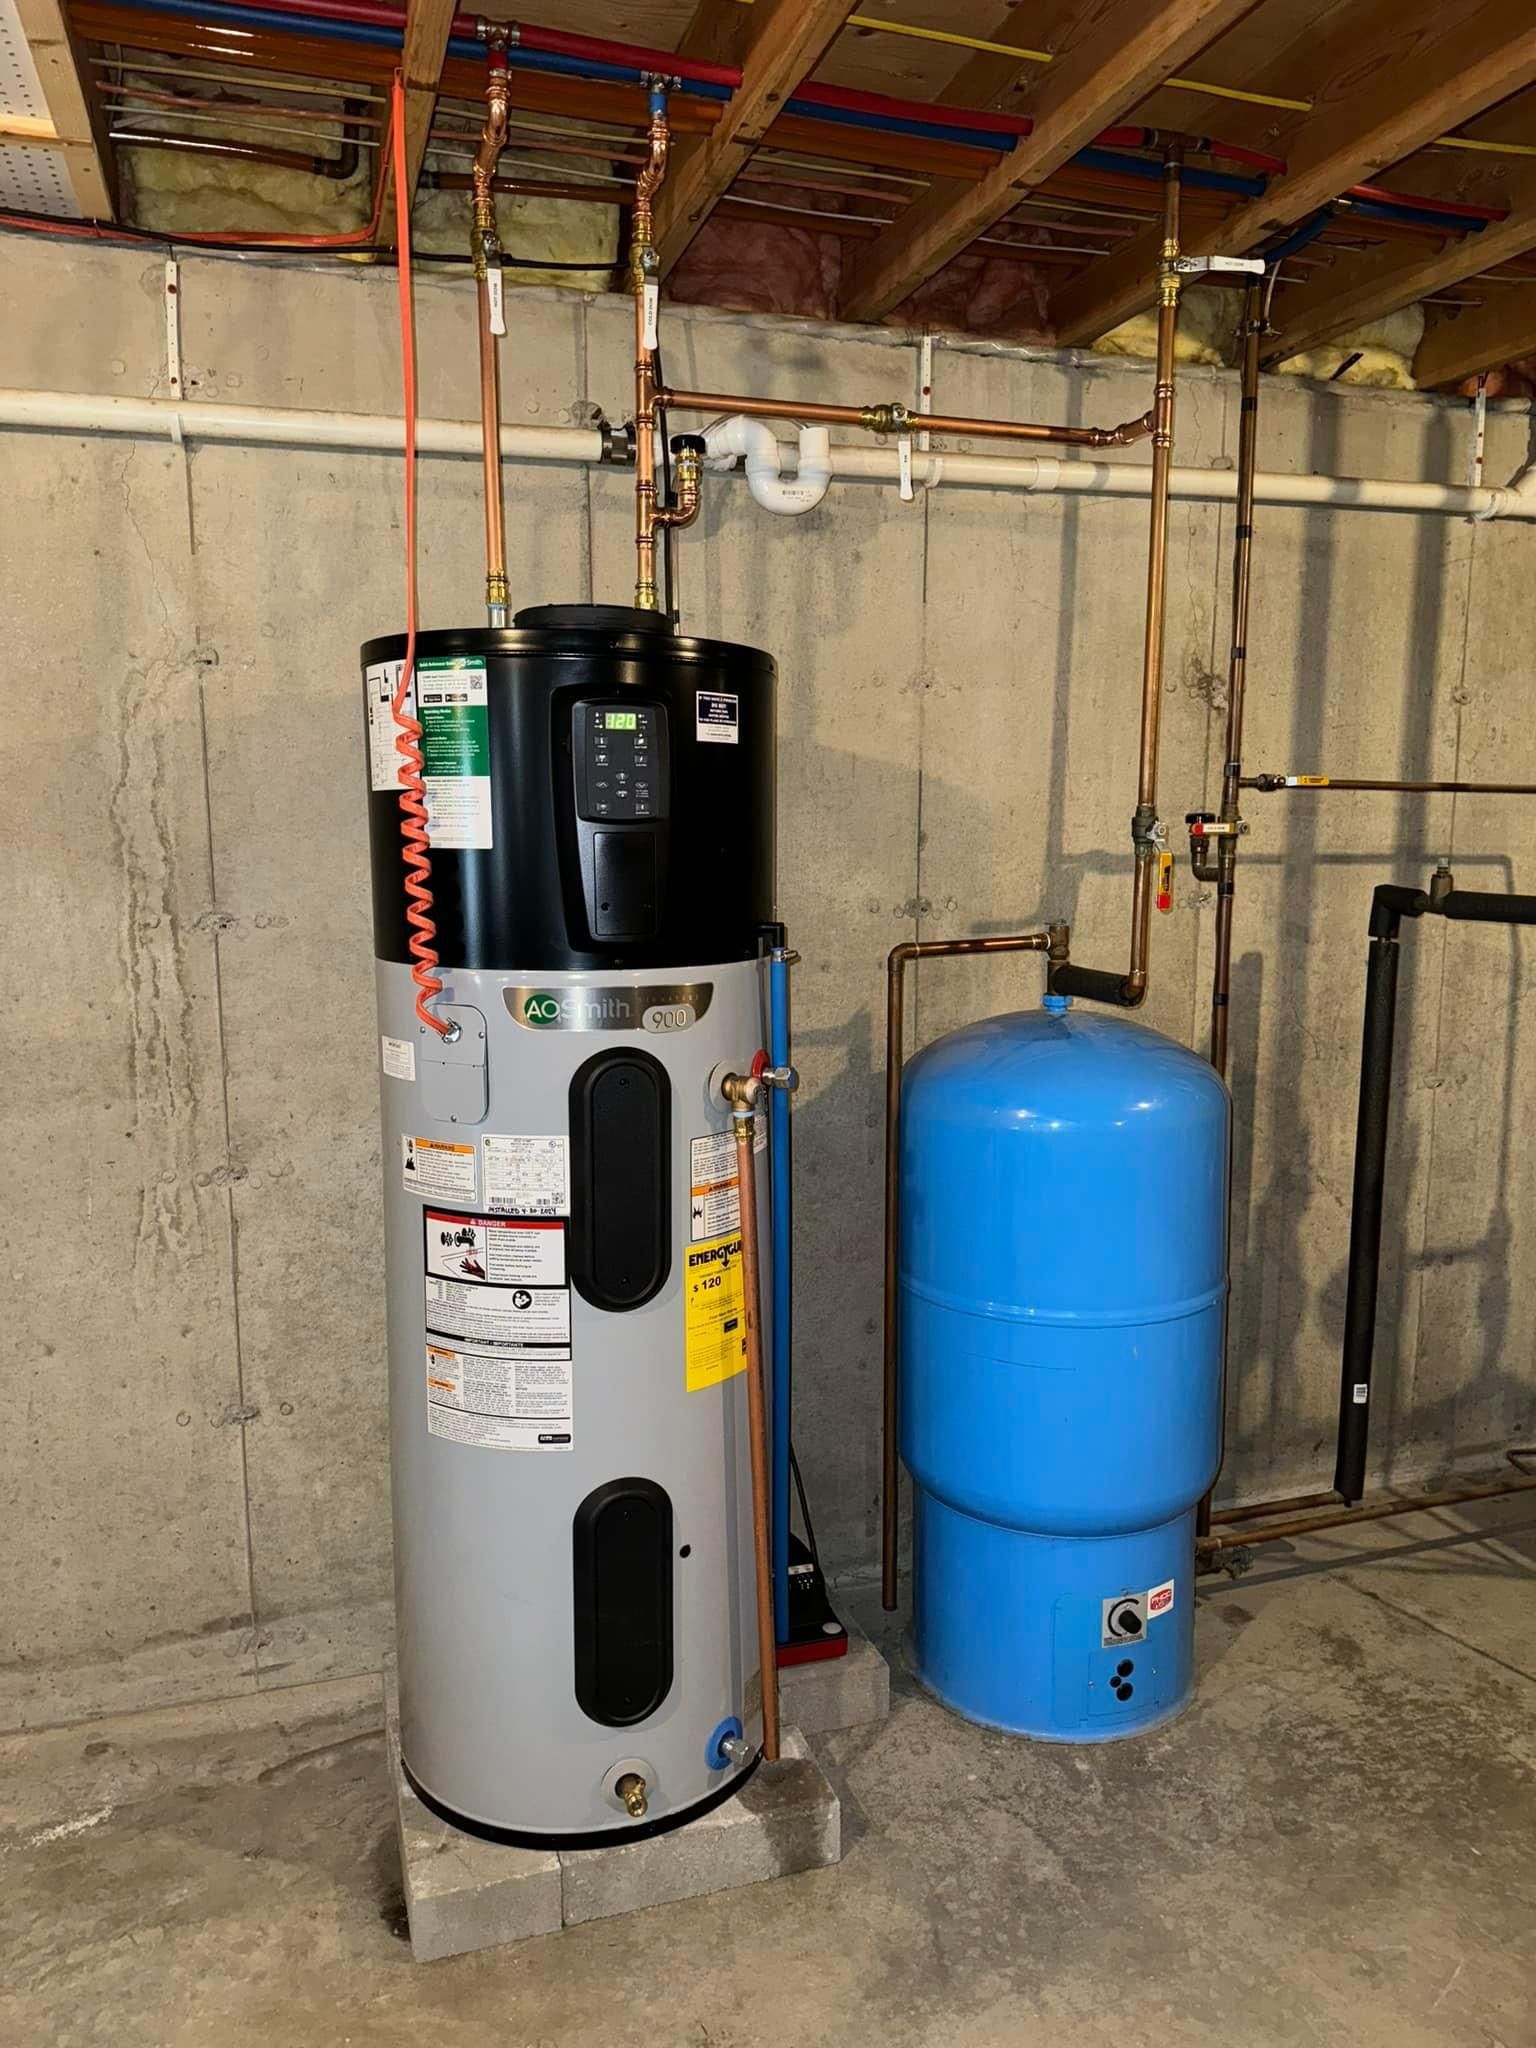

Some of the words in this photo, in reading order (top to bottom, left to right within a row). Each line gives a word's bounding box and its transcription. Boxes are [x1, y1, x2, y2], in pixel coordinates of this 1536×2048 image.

[609, 713, 636, 729] 120
[652, 1009, 687, 1028] 900
[478, 1219, 506, 1228] DANGER
[702, 1276, 721, 1290] 120
